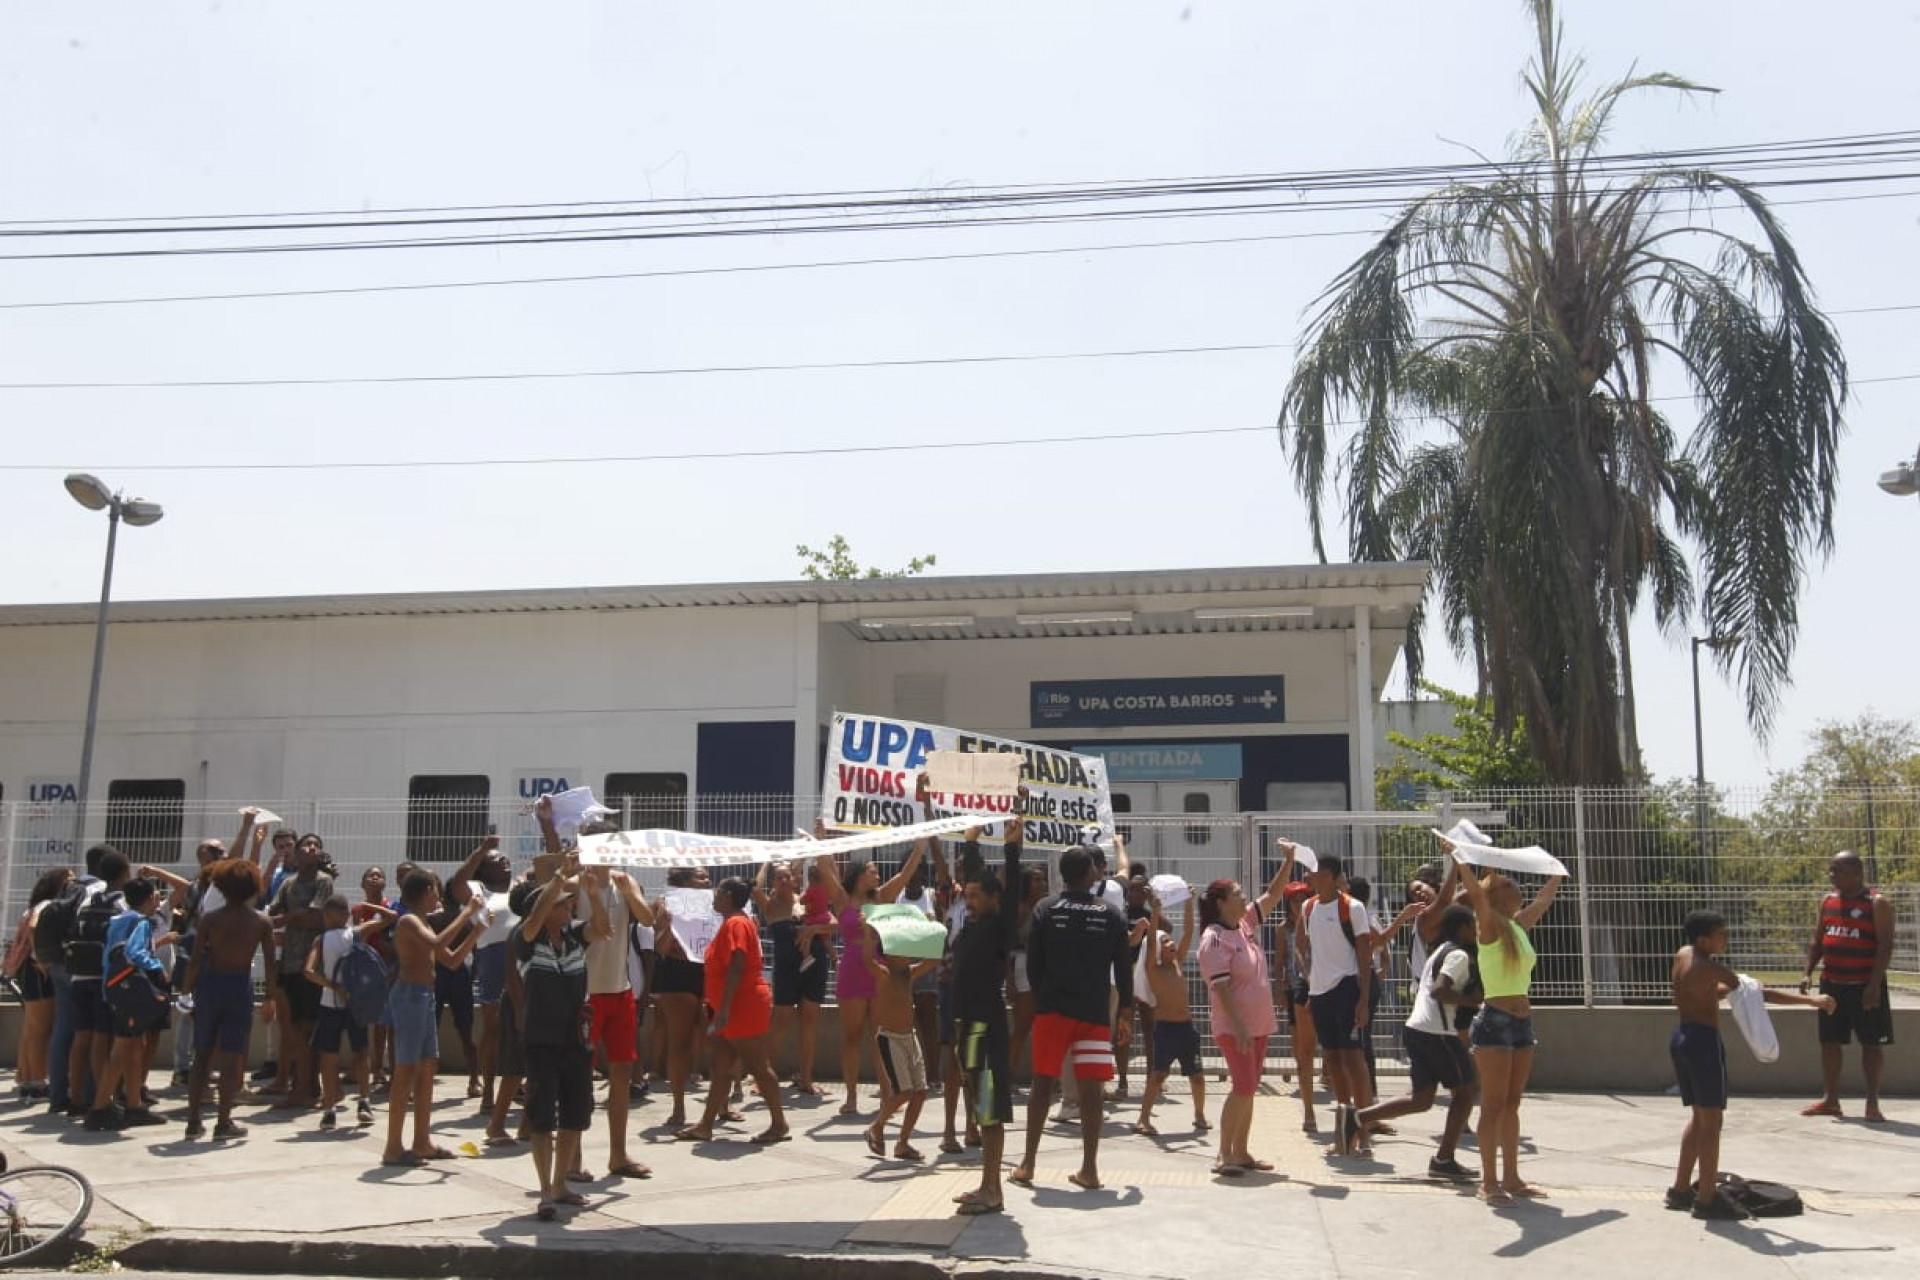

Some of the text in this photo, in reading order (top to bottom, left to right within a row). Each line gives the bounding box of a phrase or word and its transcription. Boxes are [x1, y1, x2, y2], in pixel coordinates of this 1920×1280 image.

[1078, 696, 1109, 710] UPA
[1113, 695, 1166, 710] COSTA
[1170, 694, 1234, 708] BARROS
[842, 719, 936, 770] UPA
[1109, 751, 1204, 766] ENTRADA
[30, 783, 77, 803] UPA
[519, 777, 569, 798] UPA
[838, 763, 906, 799] VIDAS
[1062, 795, 1099, 822] está
[834, 797, 848, 823] O
[853, 797, 914, 827] NOSSO
